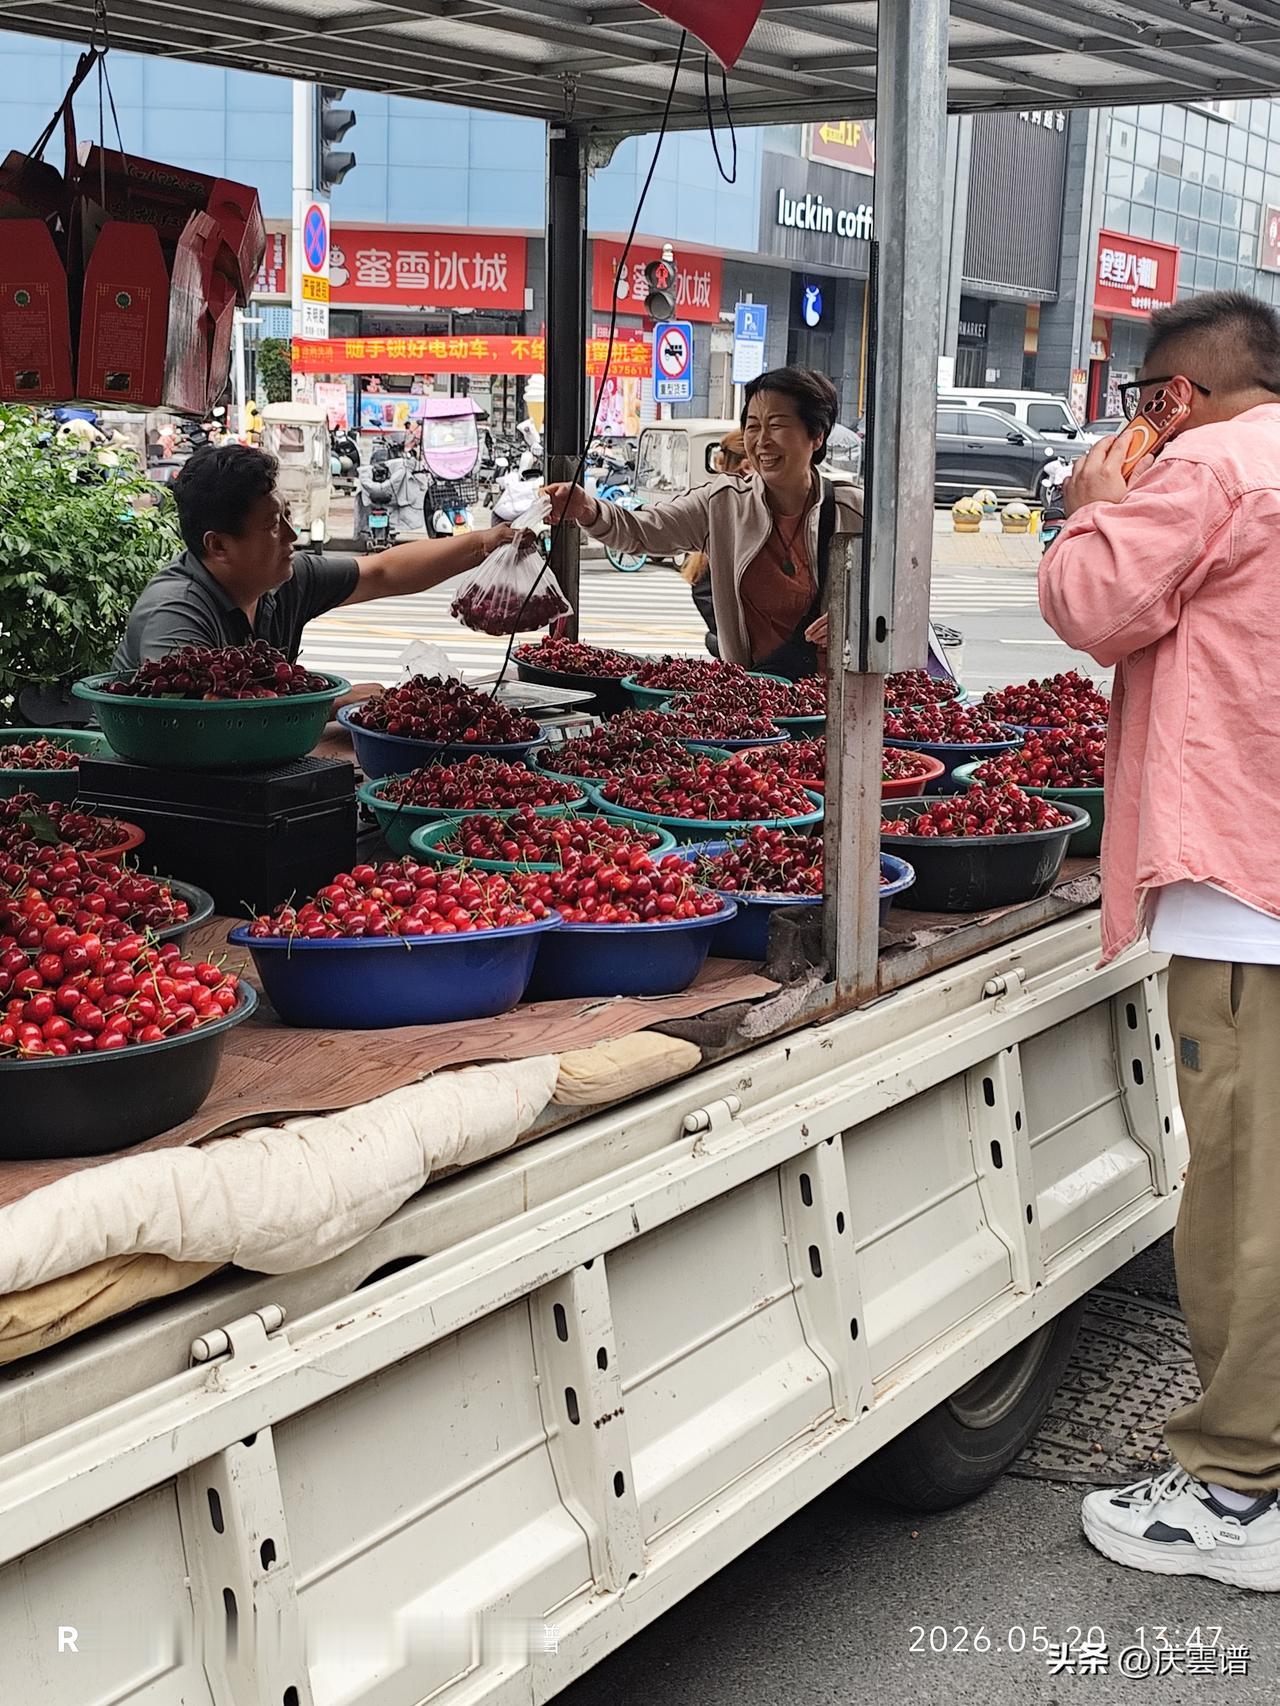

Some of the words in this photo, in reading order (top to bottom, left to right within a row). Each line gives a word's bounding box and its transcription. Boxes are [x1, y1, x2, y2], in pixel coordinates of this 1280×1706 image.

[778, 187, 833, 233] luckin
[836, 203, 874, 241] coff
[355, 248, 508, 292] 蜜雪冰城
[631, 262, 712, 308] 蜜冰城
